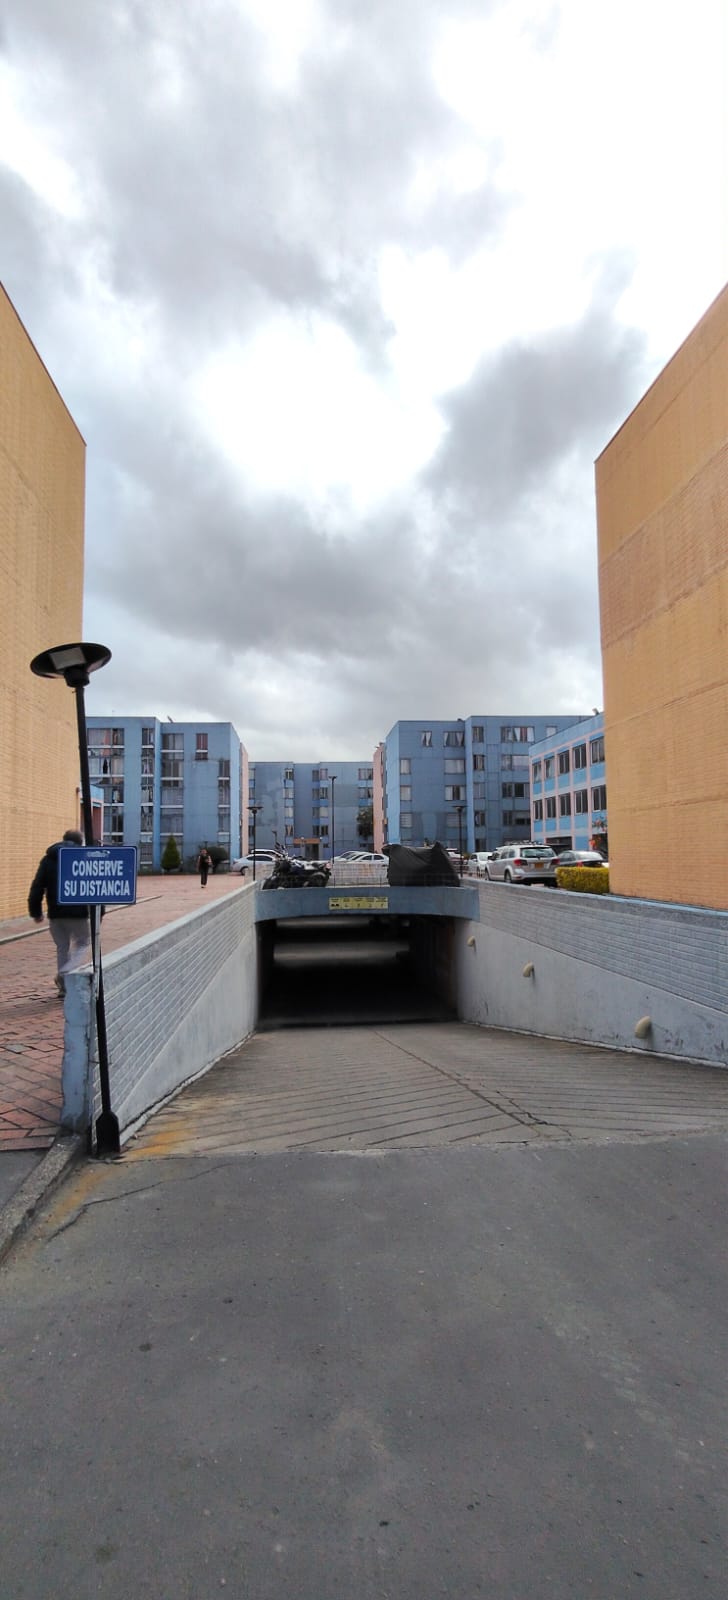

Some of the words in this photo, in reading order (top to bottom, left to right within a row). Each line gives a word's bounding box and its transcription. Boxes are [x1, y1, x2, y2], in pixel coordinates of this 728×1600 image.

[72, 860, 124, 876] CONSERVE
[64, 880, 77, 896] SU
[80, 880, 131, 896] DISTANCIA
